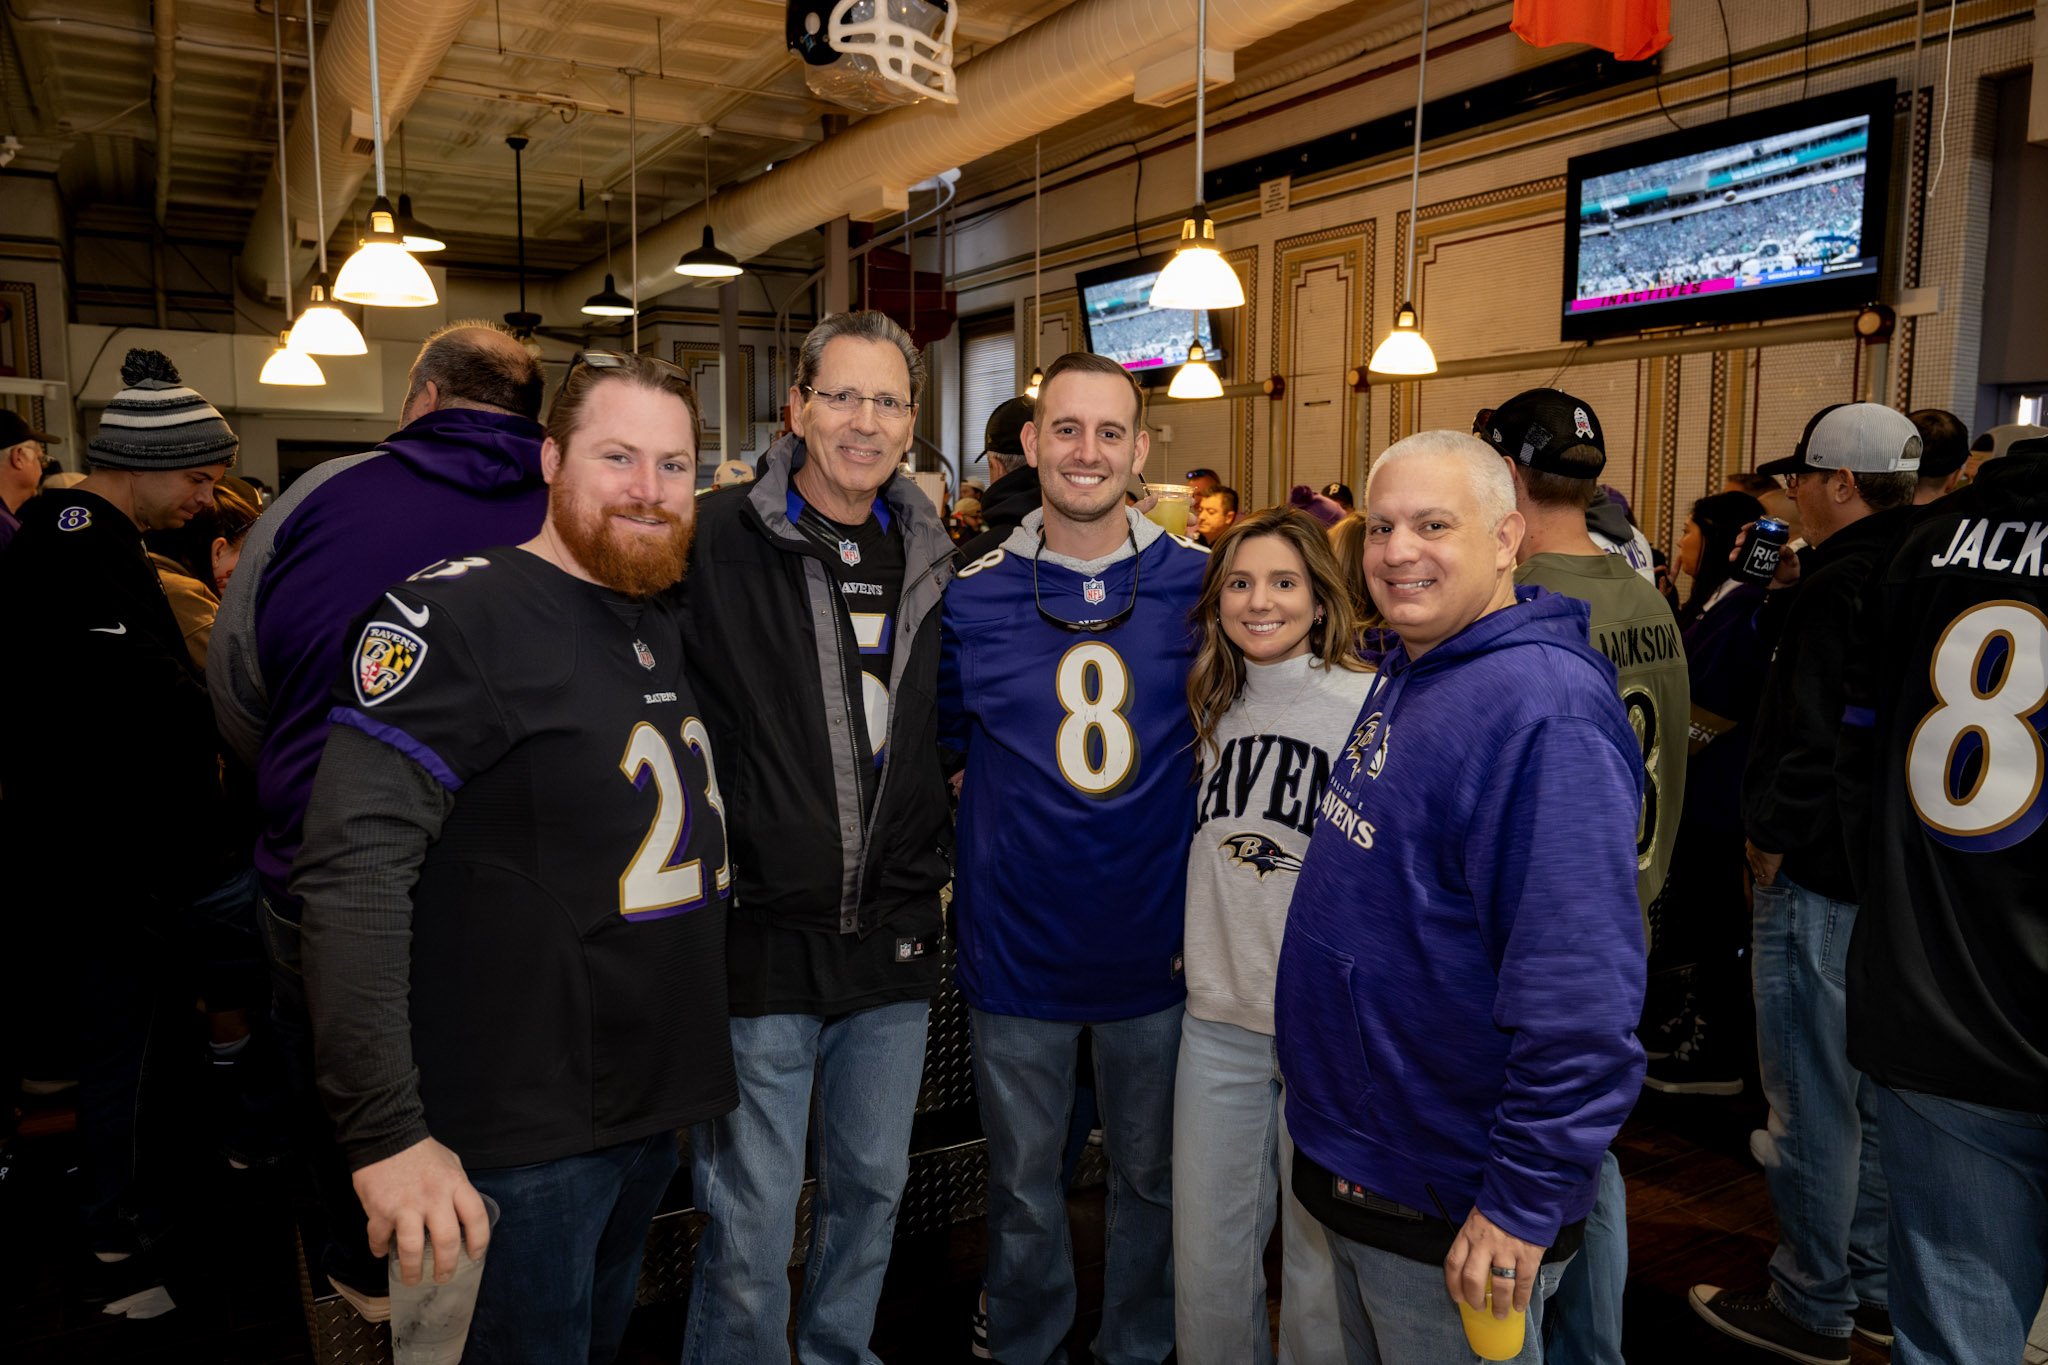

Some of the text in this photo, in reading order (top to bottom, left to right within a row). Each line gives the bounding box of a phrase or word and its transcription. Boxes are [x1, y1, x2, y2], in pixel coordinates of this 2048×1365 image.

[57, 506, 92, 532] 8
[1753, 545, 1780, 562] RIC
[1931, 517, 2048, 577] JACK
[956, 548, 1005, 579] 8
[840, 581, 884, 597] AVENS
[370, 628, 418, 653] RAVENS
[642, 691, 679, 704] RAVENS
[1055, 640, 1138, 798] 8
[1904, 599, 2048, 845] 8
[1195, 734, 1332, 838] AVEN
[1320, 789, 1377, 850] AVENS
